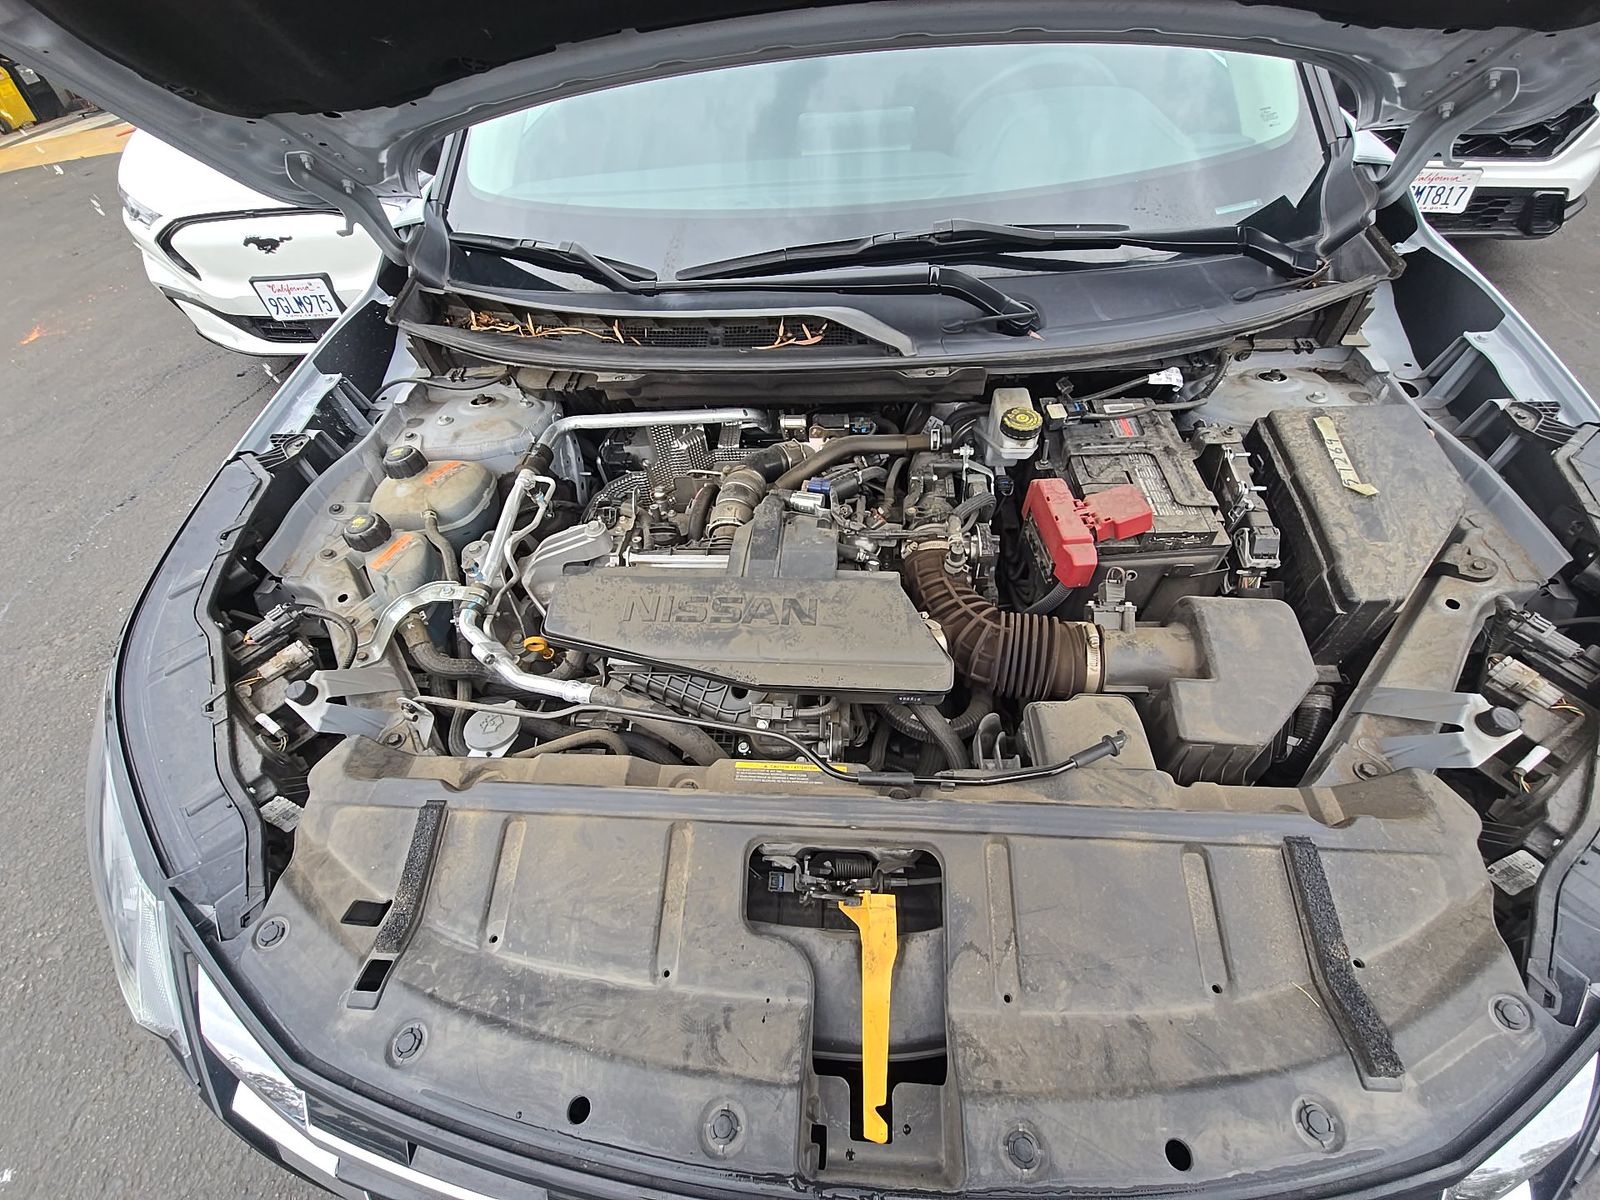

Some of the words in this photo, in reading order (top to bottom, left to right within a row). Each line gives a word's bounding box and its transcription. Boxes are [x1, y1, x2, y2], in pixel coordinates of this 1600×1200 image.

[1411, 185, 1468, 206] MT817
[268, 284, 314, 295] California
[268, 294, 333, 315] 9GLM975
[621, 595, 818, 626] NISSAN
